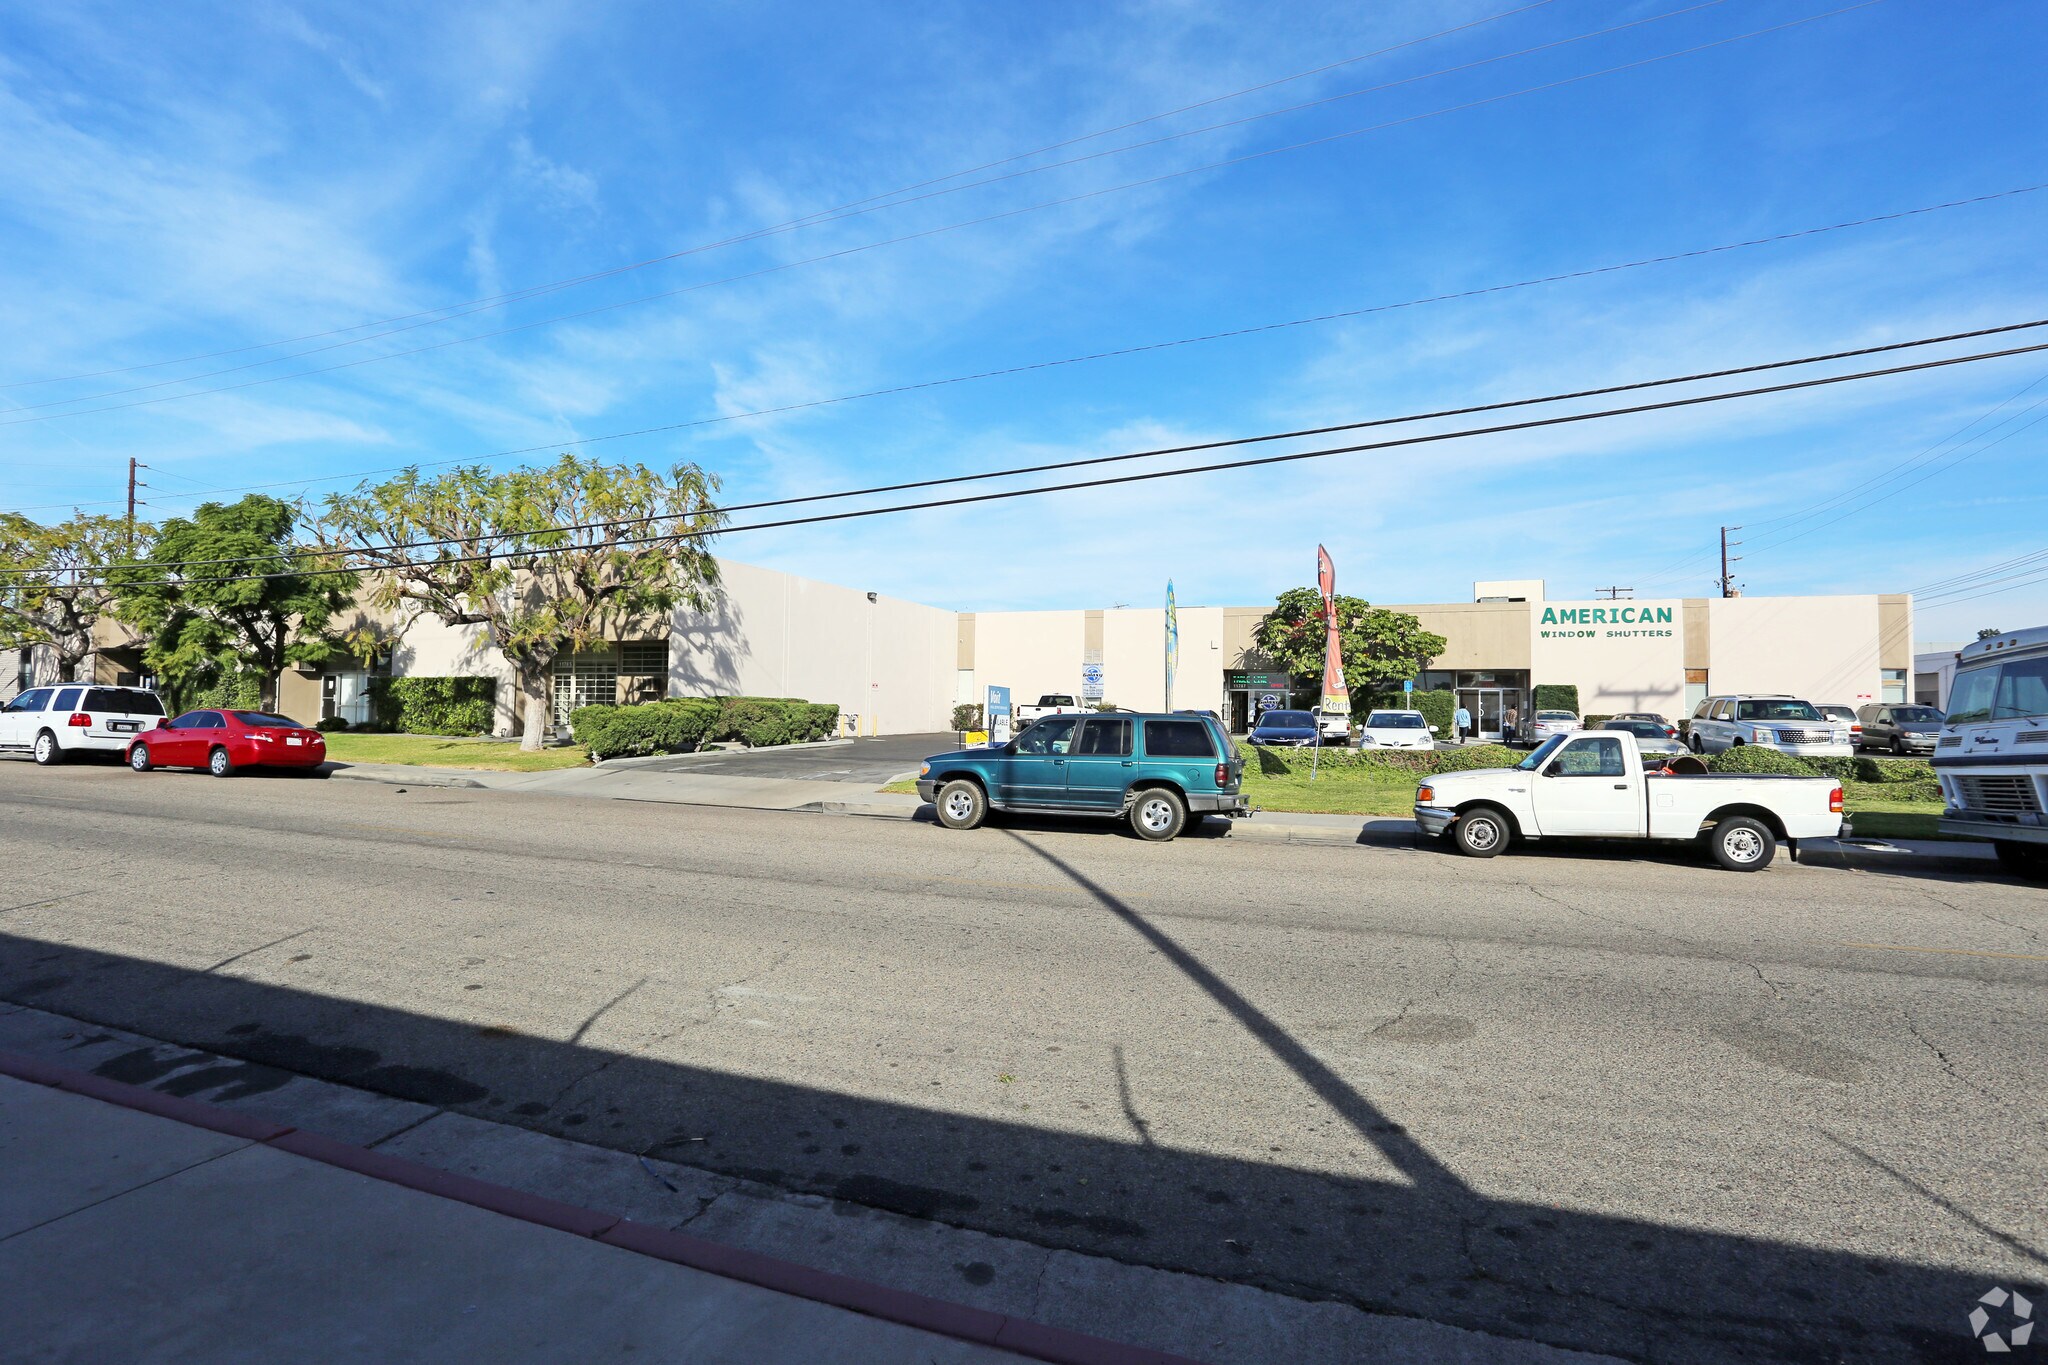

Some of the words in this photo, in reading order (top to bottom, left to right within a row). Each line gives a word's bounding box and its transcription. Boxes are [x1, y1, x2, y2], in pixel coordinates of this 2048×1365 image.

[1540, 607, 1673, 625] AMERICAN
[1540, 630, 1597, 638] WINDOW
[1606, 629, 1673, 638] SHUTTERS
